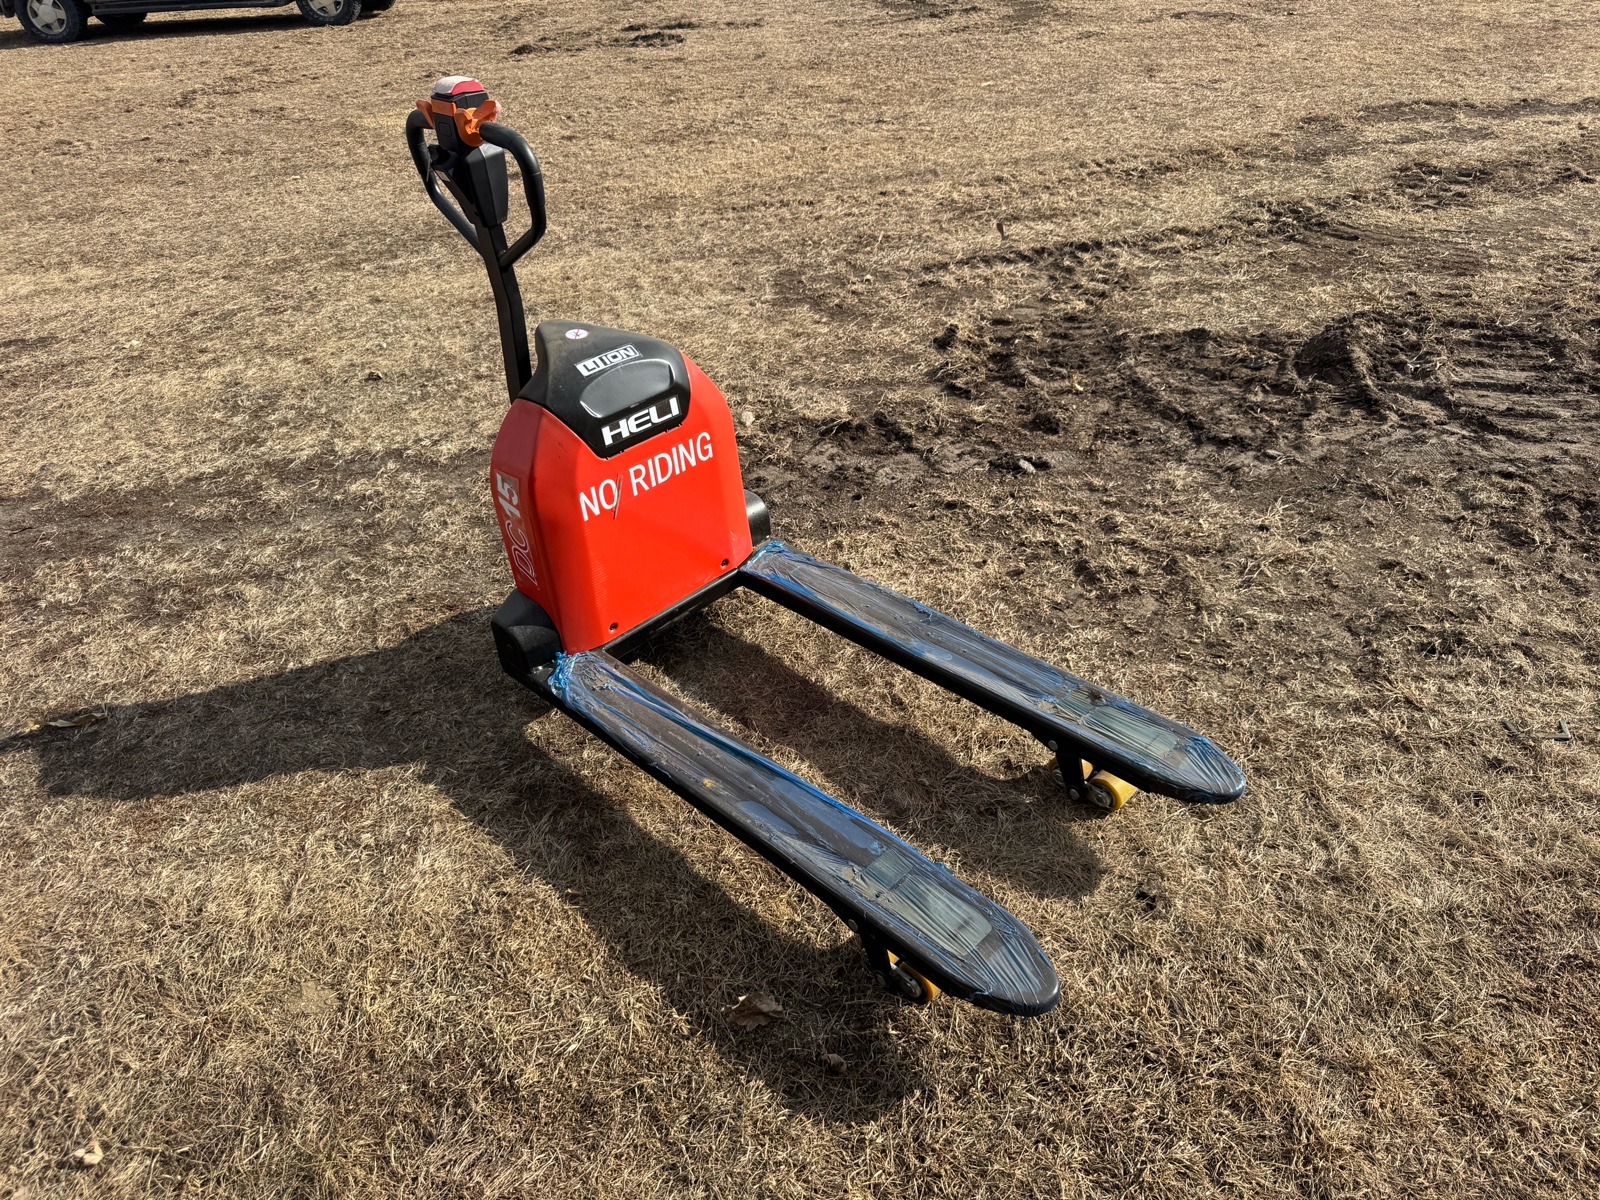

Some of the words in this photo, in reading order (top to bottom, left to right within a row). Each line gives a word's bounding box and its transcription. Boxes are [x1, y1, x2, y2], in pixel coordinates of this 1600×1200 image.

[601, 396, 680, 446] HELI
[579, 478, 618, 522] NO
[629, 431, 714, 497] RIDING
